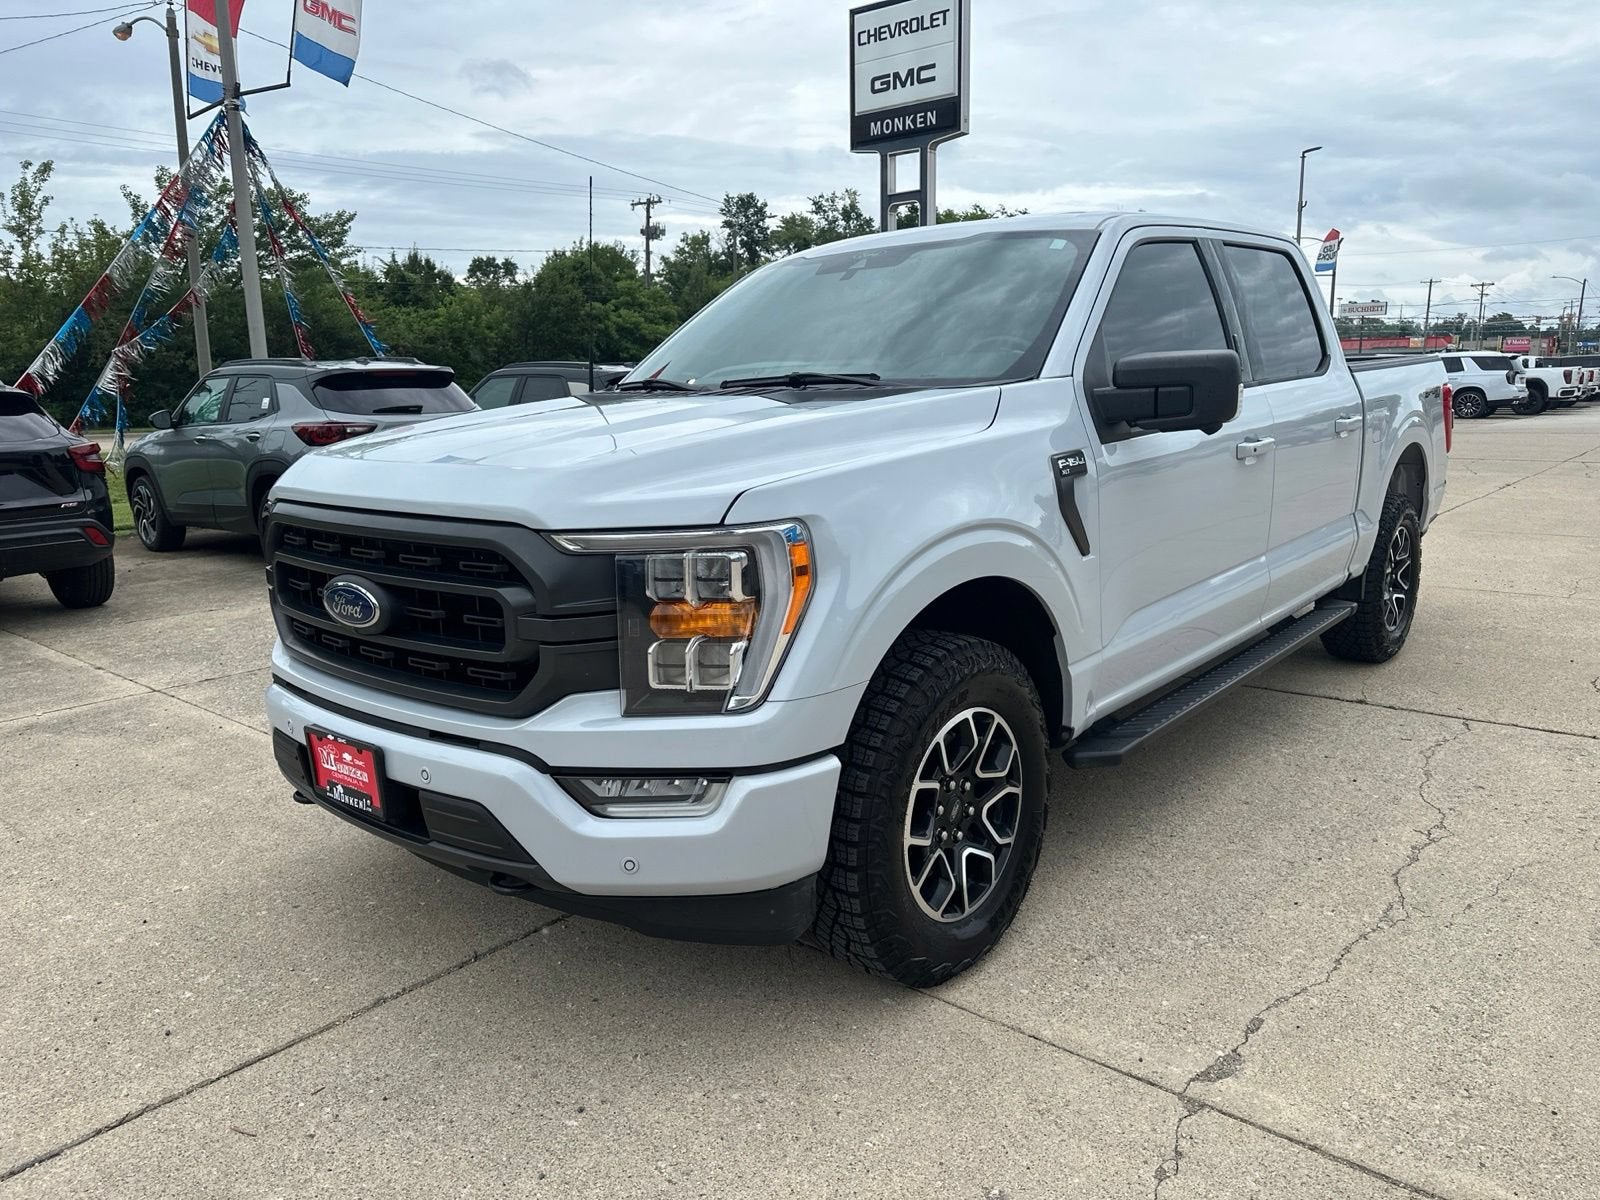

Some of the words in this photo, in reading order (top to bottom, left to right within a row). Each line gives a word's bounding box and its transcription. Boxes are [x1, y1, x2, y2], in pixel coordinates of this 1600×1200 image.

[303, 0, 357, 36] GMC
[857, 8, 950, 46] CHEVROLET
[870, 62, 936, 94] GMC
[870, 110, 937, 136] MONKEN
[332, 591, 363, 618] Ford
